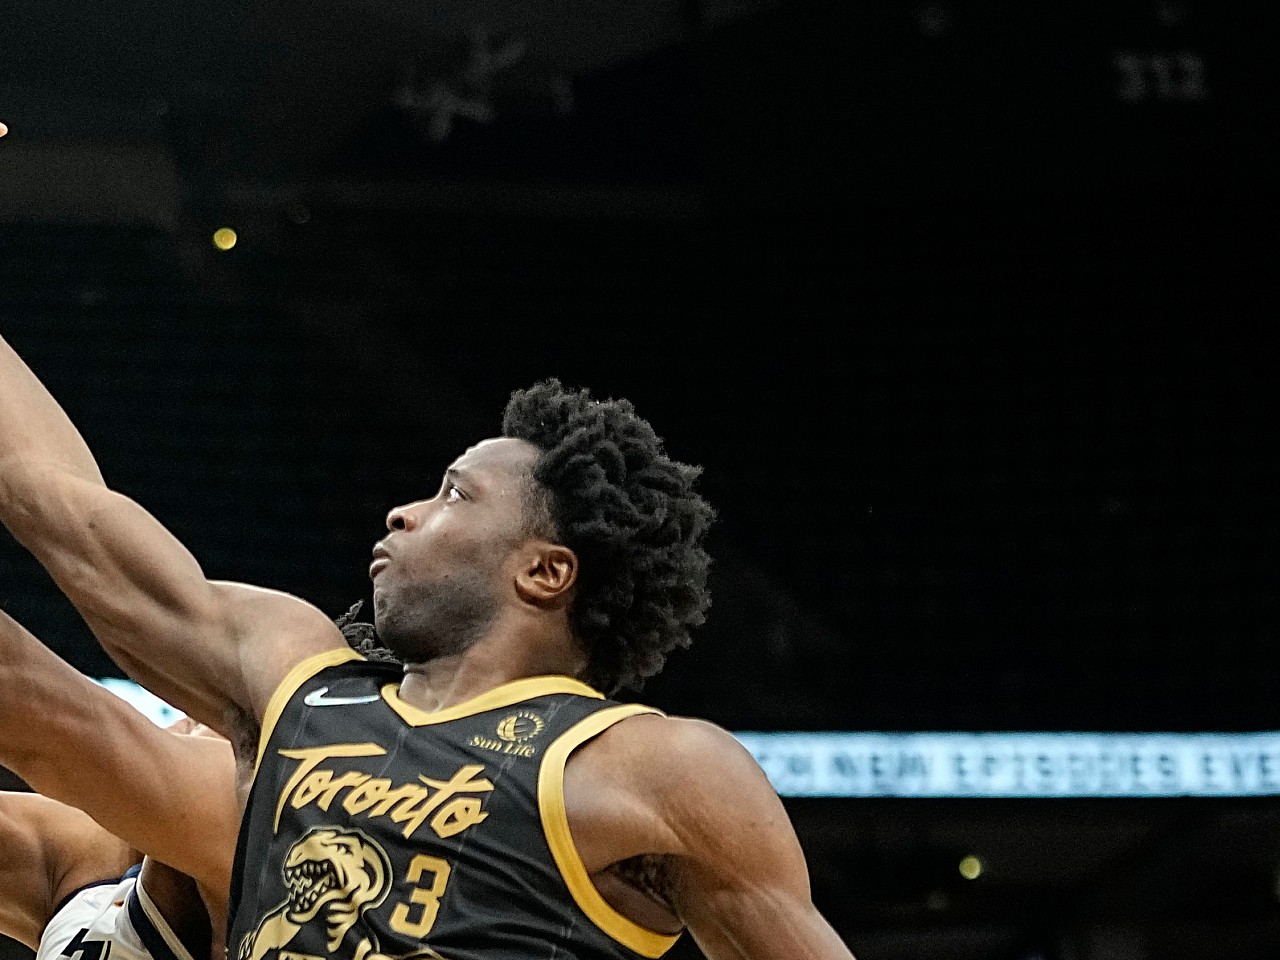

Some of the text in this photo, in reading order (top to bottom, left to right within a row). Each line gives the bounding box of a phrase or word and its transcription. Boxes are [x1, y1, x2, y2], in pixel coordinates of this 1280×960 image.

[469, 735, 536, 758] Sun Life
[832, 754, 927, 778] NEW
[273, 741, 495, 840] Toronto
[389, 853, 452, 939] 3
